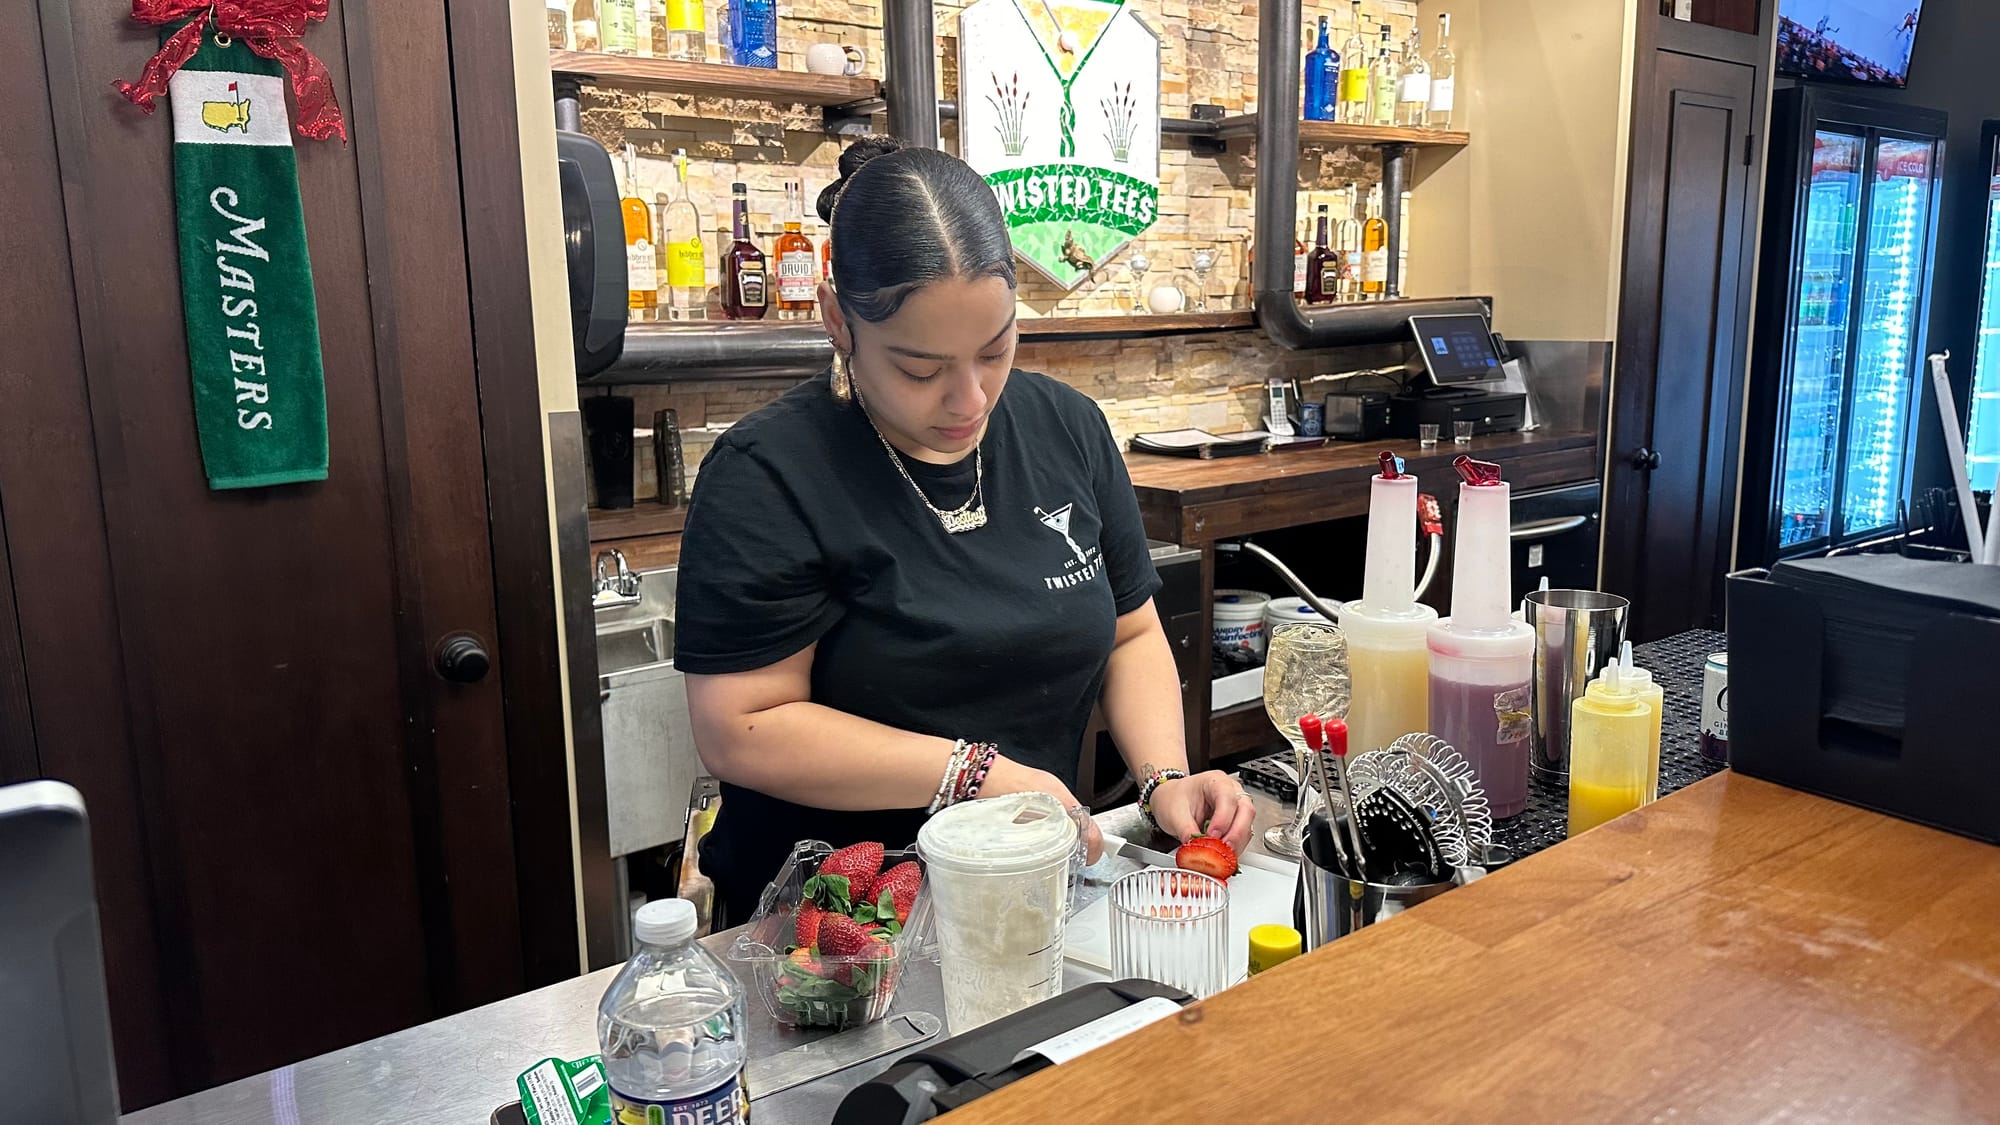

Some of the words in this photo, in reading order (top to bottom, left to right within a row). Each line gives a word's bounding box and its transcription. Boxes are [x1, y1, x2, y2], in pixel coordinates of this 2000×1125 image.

[1908, 161, 1924, 173] COLD
[992, 174, 1091, 216] WISTED
[1099, 178, 1156, 223] TEES
[781, 263, 809, 277] DAVID
